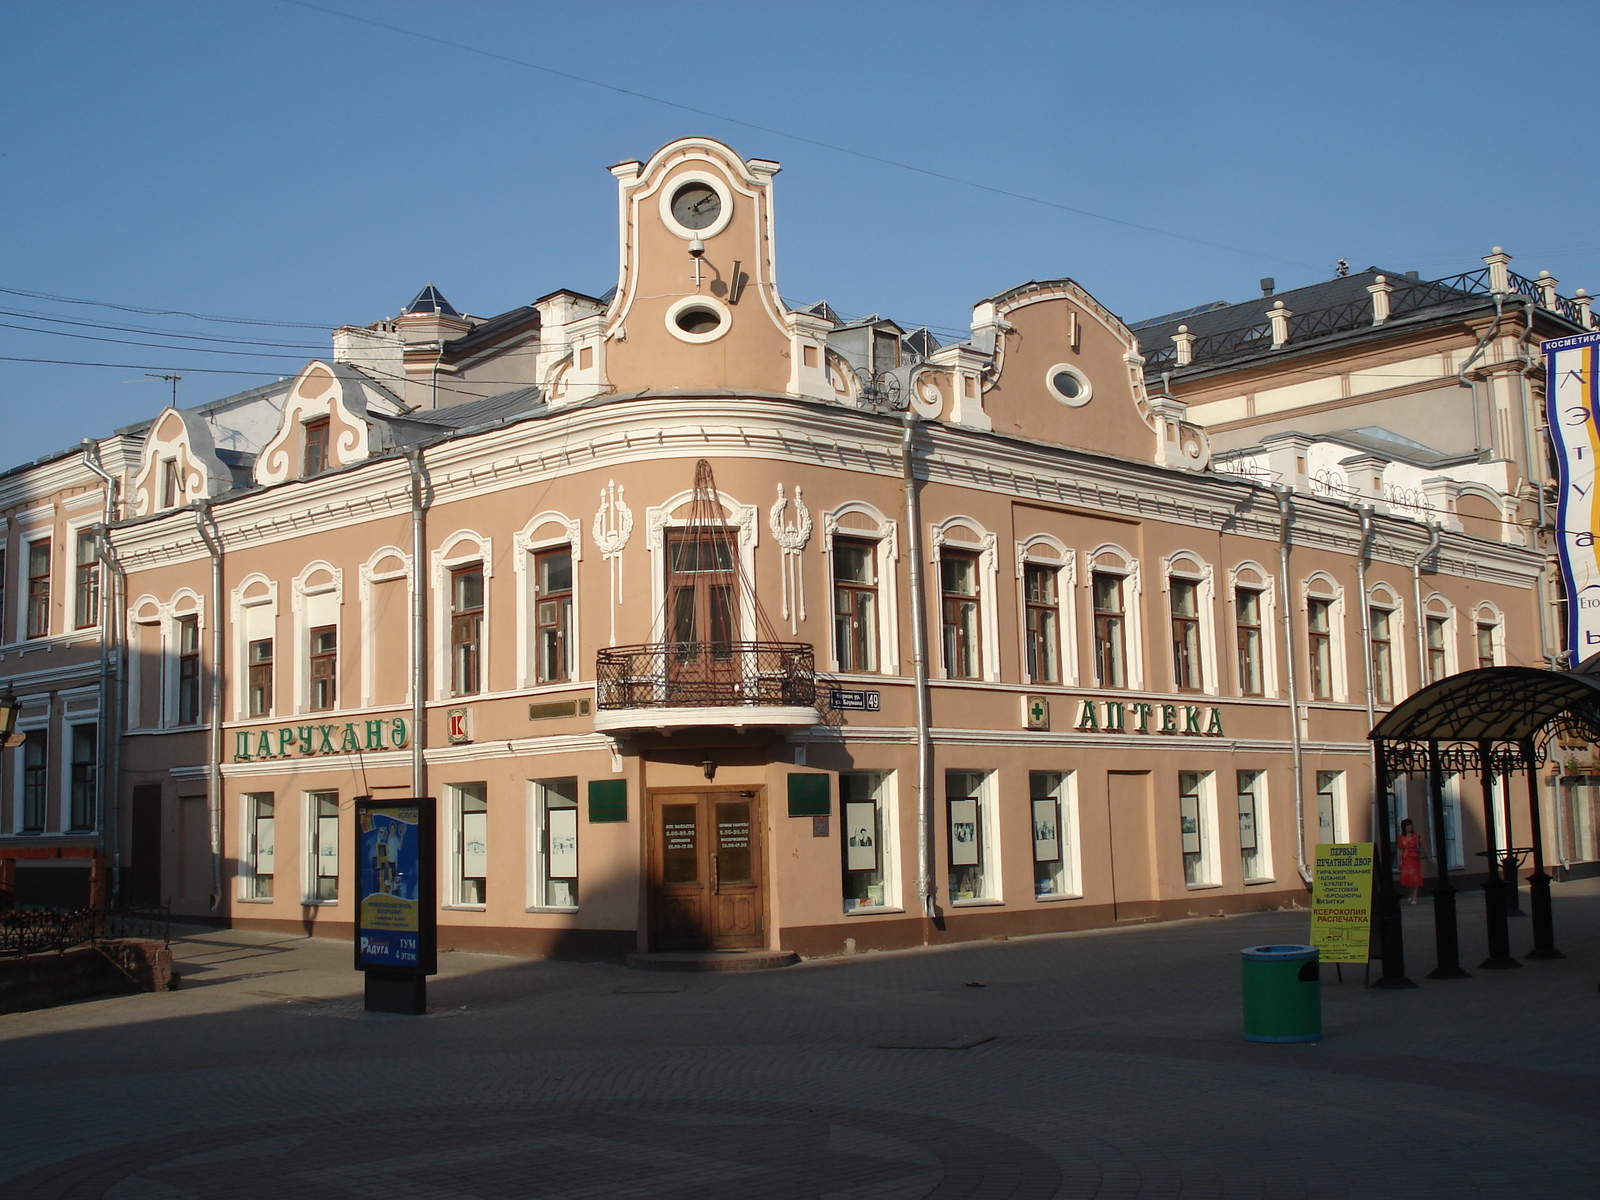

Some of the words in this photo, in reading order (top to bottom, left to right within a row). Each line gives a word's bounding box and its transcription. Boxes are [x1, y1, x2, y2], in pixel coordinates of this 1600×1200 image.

[1545, 333, 1600, 350] КОСМЕТИКА
[868, 694, 878, 708] 49
[1074, 700, 1223, 733] АПТЕКА
[234, 717, 409, 763] ДАРУХАНӘ
[1330, 846, 1357, 856] ПЕРВЫЙ
[1316, 856, 1352, 867] ПЕЧАТНЫЙ
[1353, 858, 1371, 867] ДВОР
[400, 938, 416, 949] ГУМ
[395, 950, 400, 959] 4
[400, 953, 417, 961] этаж
